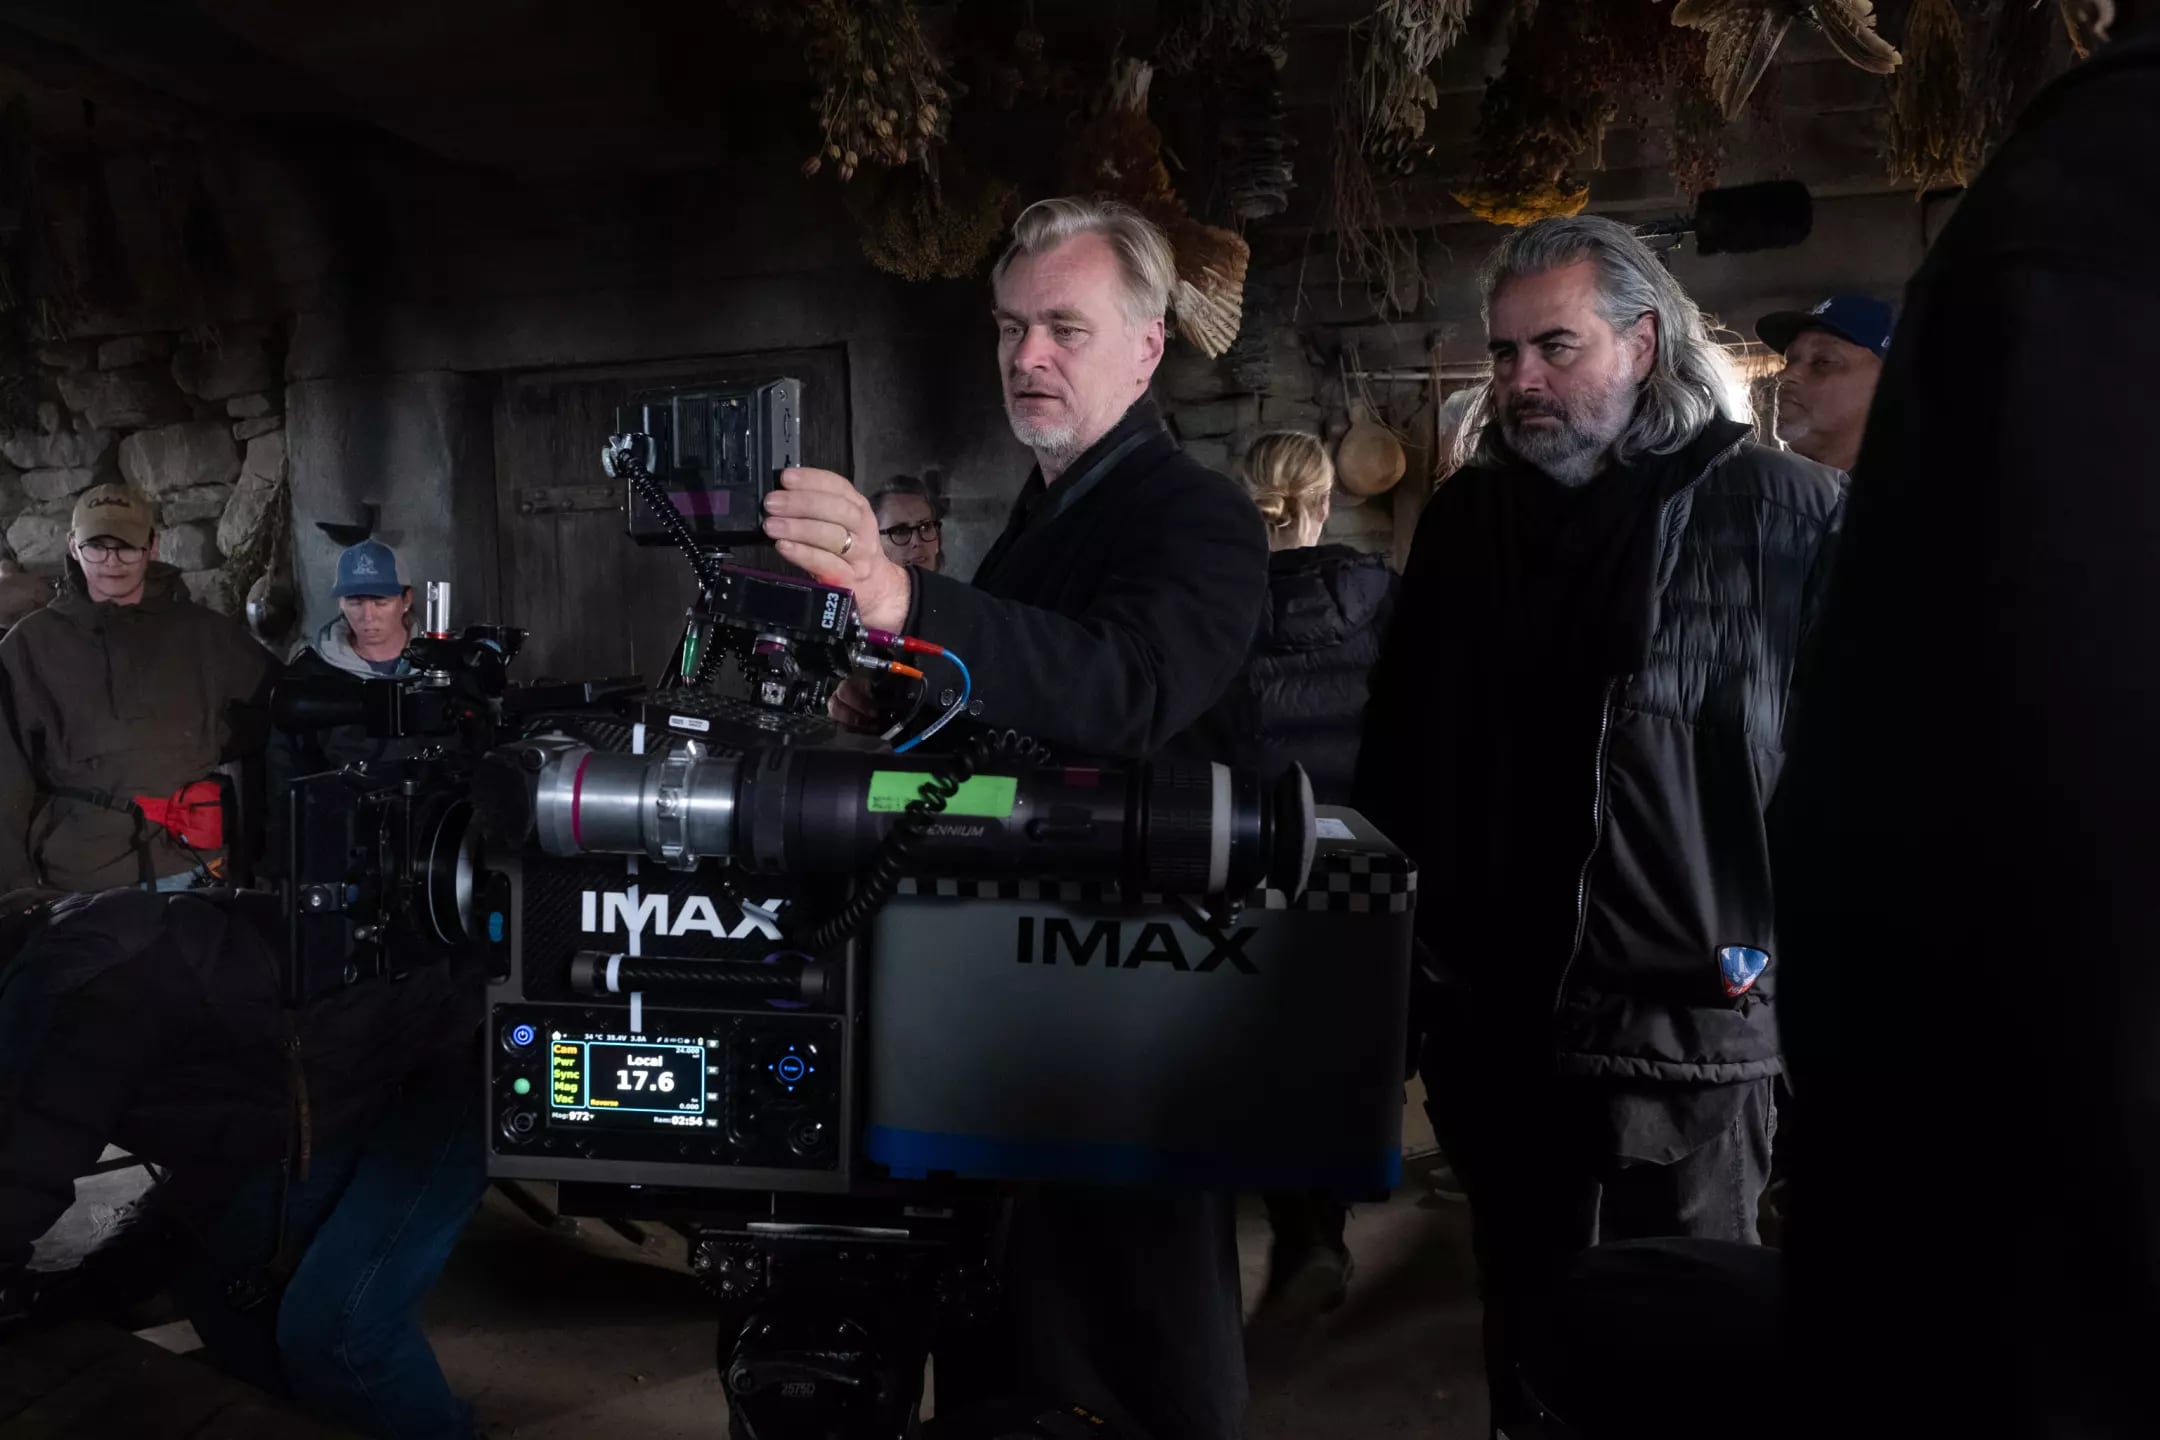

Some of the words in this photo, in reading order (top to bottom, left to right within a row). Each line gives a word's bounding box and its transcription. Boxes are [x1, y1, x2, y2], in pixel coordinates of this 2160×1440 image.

[581, 890, 784, 940] IMAX
[1017, 916, 1260, 975] IMAX
[553, 1044, 578, 1054] Cam
[553, 1057, 576, 1067] Pwr
[627, 1054, 663, 1068] Local
[553, 1069, 580, 1081] Sync
[616, 1070, 675, 1092] 17.6
[554, 1081, 578, 1093] Mag
[554, 1094, 575, 1104] Vac
